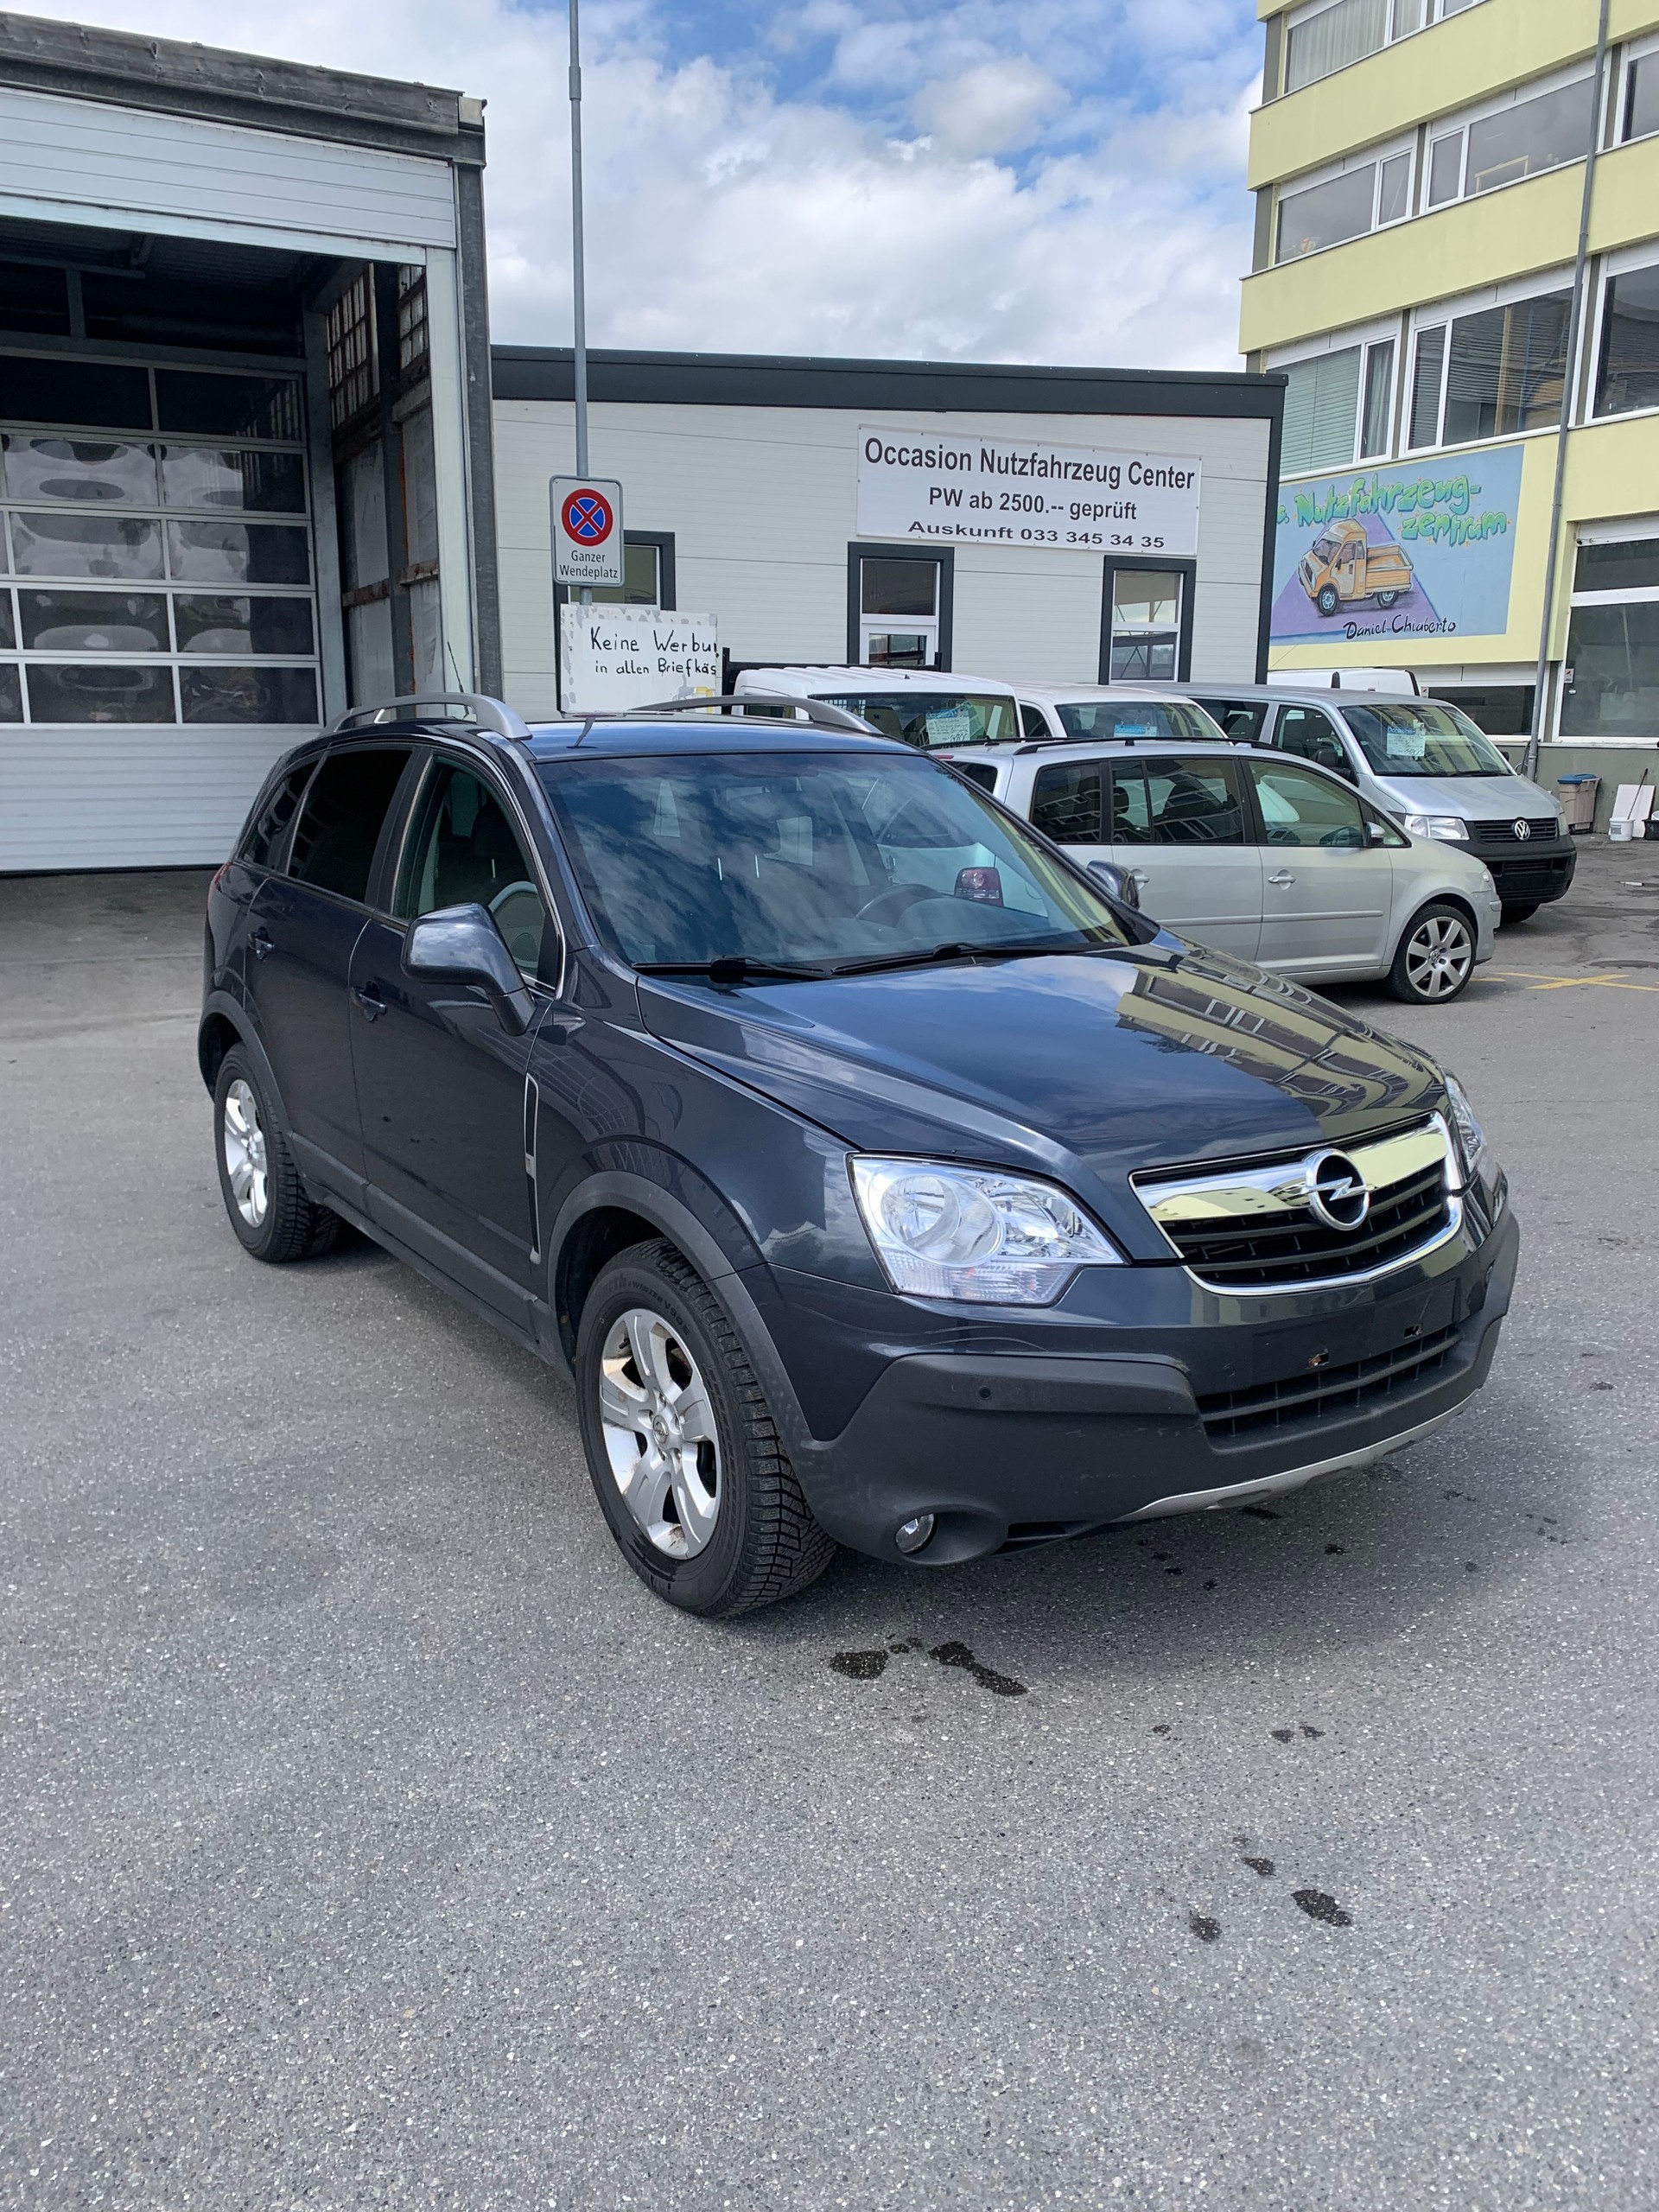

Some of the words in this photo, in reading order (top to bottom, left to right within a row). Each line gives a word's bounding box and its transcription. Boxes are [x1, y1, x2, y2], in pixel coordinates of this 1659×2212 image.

[865, 437, 972, 472] Occasion
[980, 448, 1122, 490] Nutzfahrzeug
[1128, 461, 1196, 489] Center
[929, 486, 963, 507] PW
[969, 491, 993, 510] ab
[999, 493, 1065, 515] 2500.--
[1069, 500, 1137, 522] geprüft
[907, 520, 1014, 539] Auskunft
[1020, 528, 1058, 542] 033
[1065, 531, 1103, 544] 345
[1109, 534, 1135, 547] 34
[1141, 536, 1165, 549] 35
[570, 550, 607, 563] Ganzer
[559, 564, 619, 580] Wendeplatz
[590, 626, 640, 652] Keine
[1343, 620, 1387, 639] Daniel
[595, 660, 607, 674] in
[615, 660, 650, 676] allen
[658, 658, 717, 677] Briefkäs
